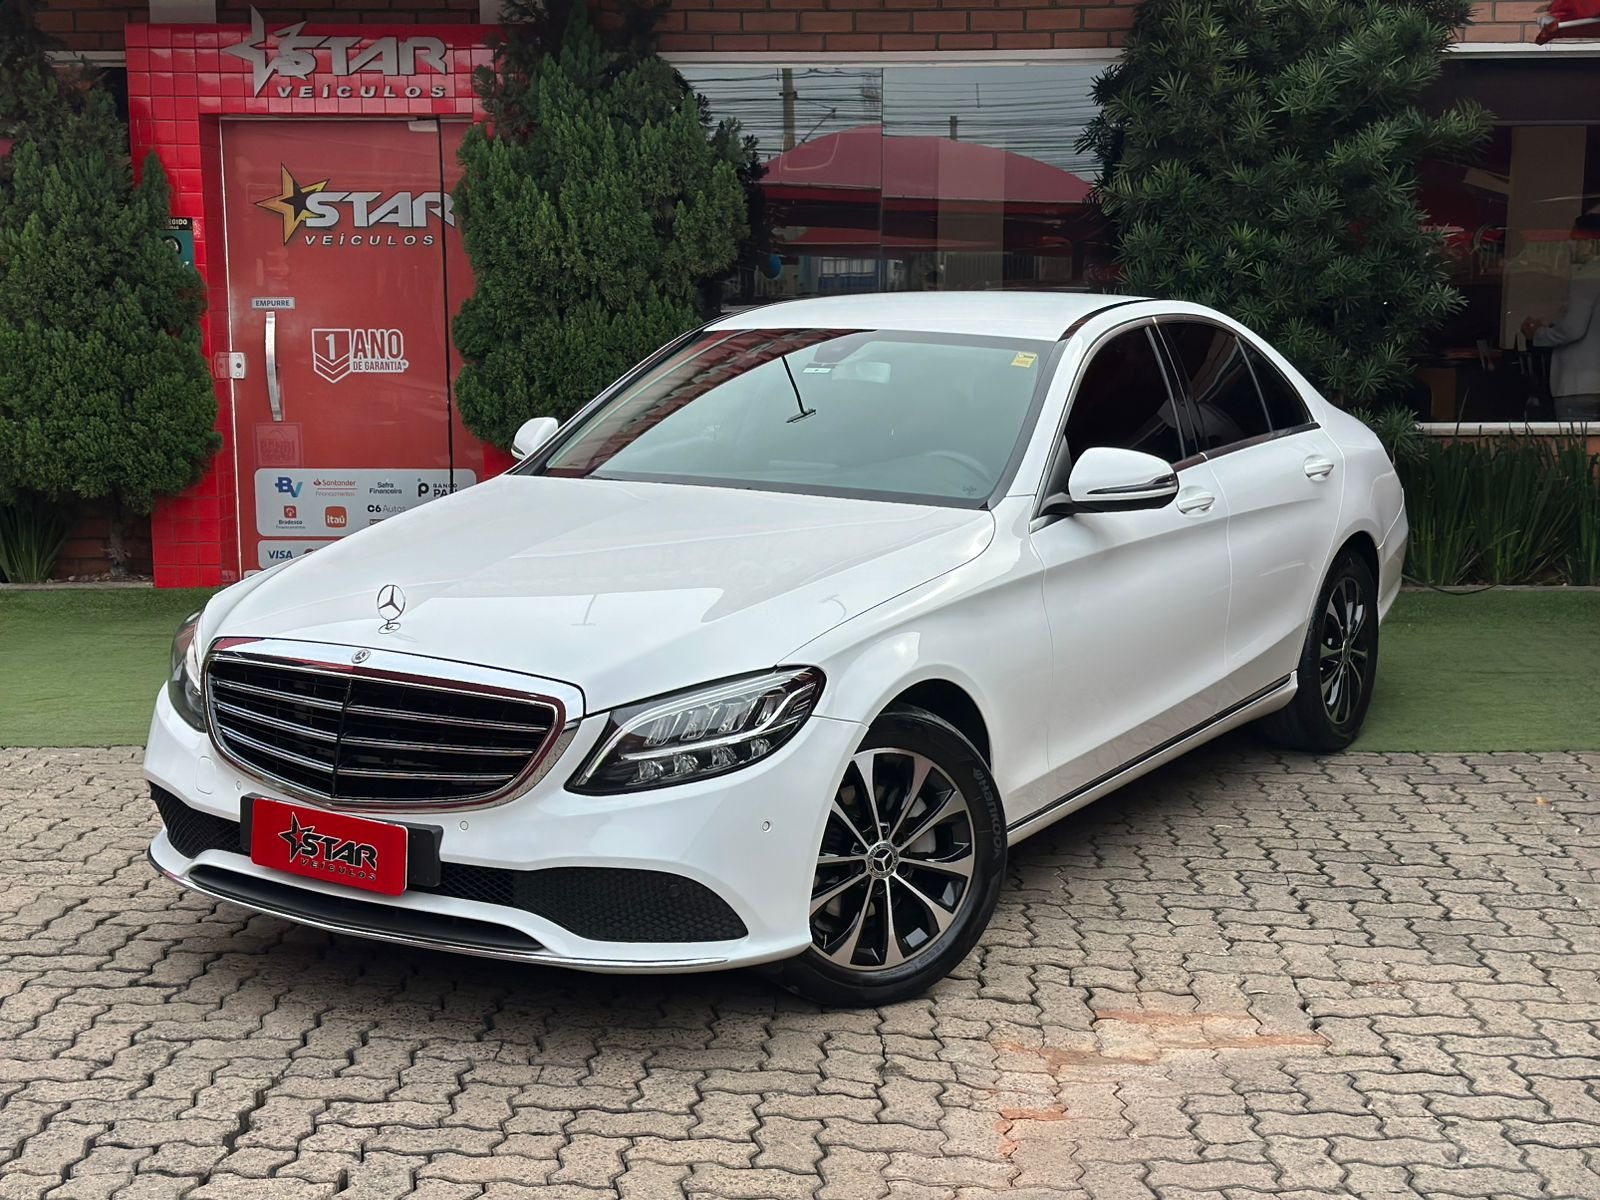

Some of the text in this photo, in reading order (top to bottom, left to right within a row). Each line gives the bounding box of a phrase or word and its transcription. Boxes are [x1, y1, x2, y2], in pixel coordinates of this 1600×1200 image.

[278, 36, 447, 78] STAR
[277, 85, 446, 98] VEÍCULOS
[305, 191, 456, 228] STAR
[304, 233, 435, 246] VEÍCULOS
[325, 330, 403, 361] 1 ANO
[353, 361, 363, 371] DE
[275, 476, 303, 498] BV
[322, 479, 357, 487] Santander
[367, 504, 382, 513] C6
[268, 550, 294, 560] VISA
[301, 831, 378, 871] STAR
